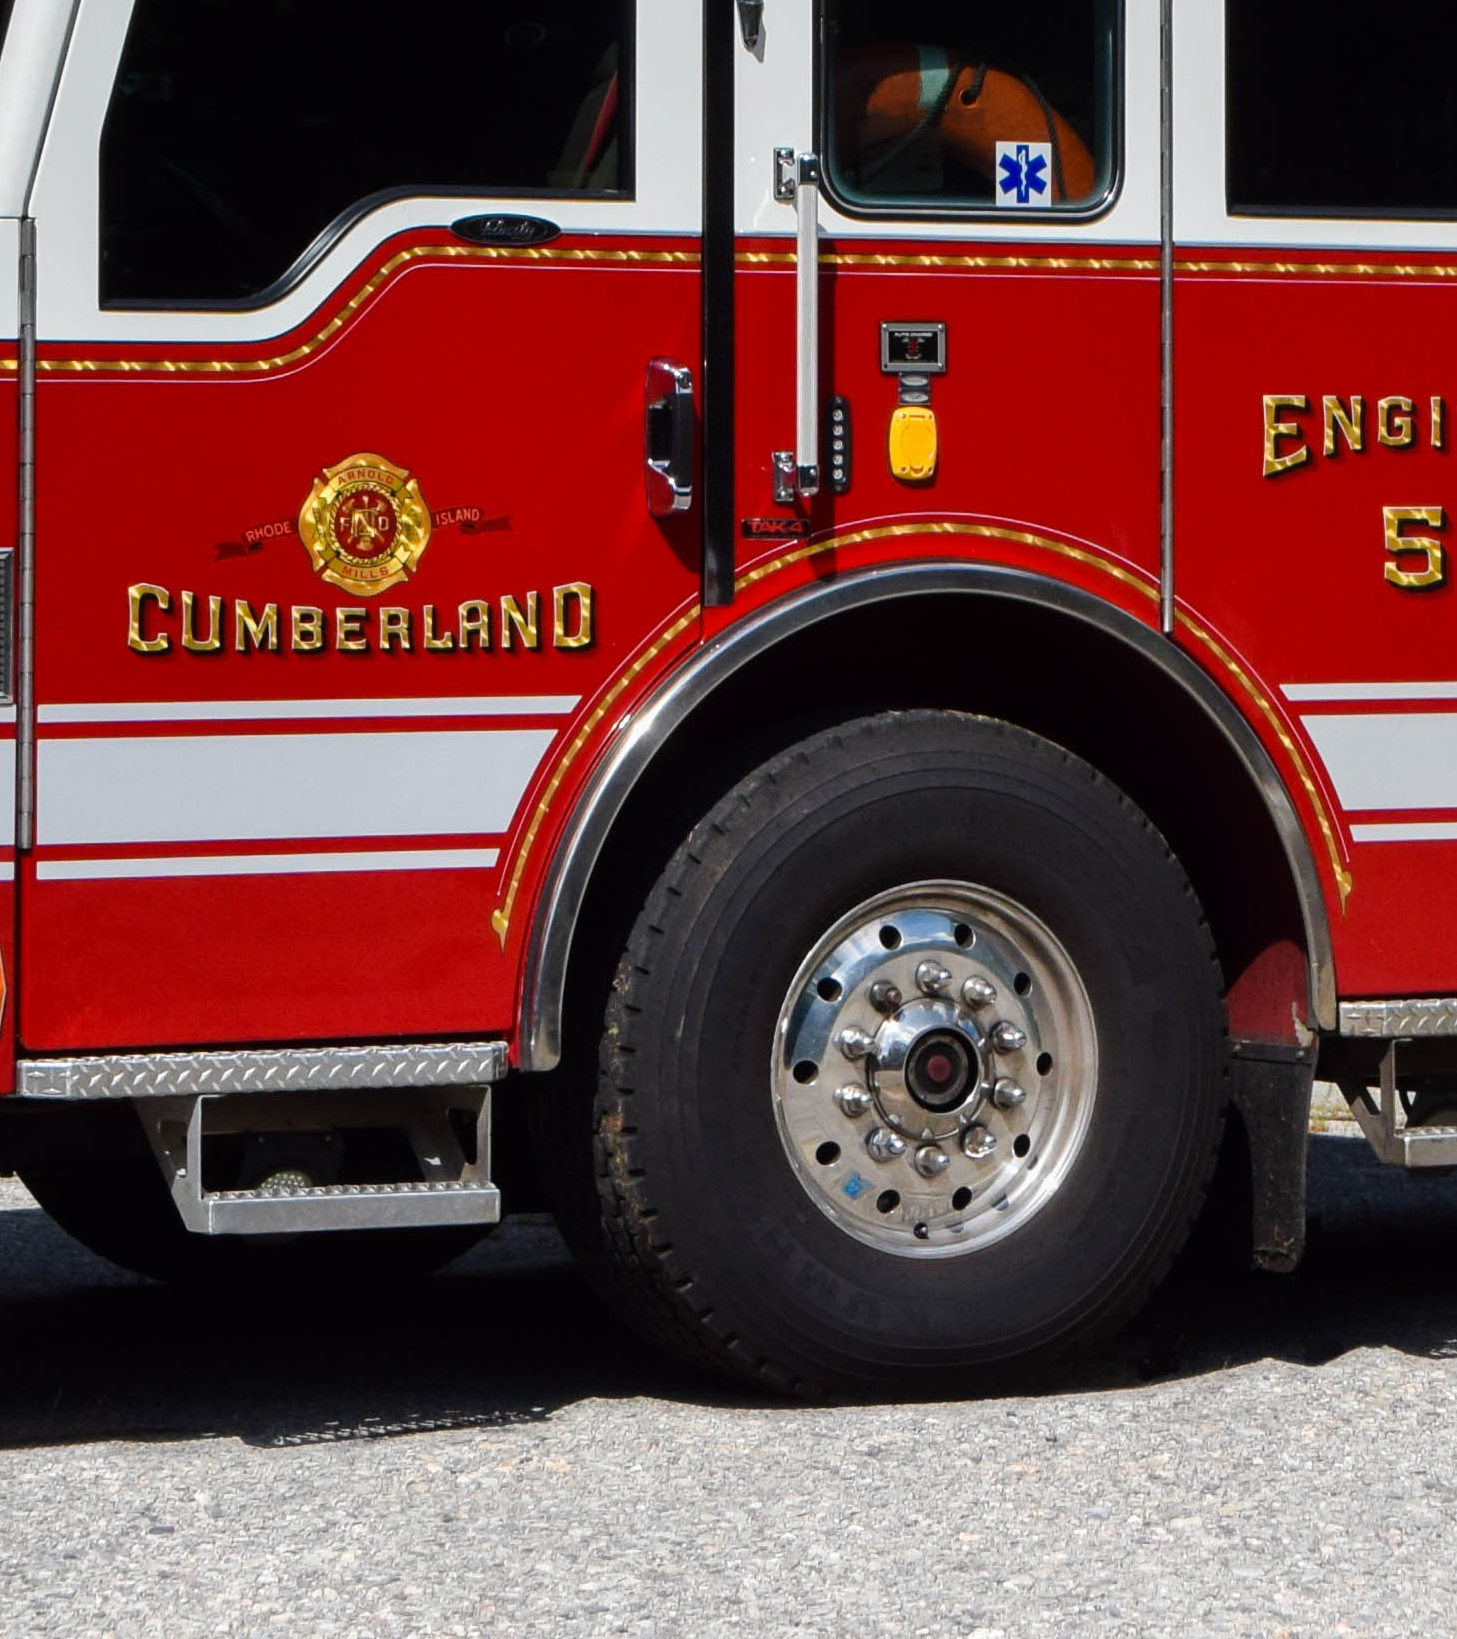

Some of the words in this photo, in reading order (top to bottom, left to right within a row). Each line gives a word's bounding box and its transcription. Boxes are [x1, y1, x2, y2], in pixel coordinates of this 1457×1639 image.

[337, 468, 395, 485] ARNOLD
[245, 521, 292, 543] RHODE
[436, 507, 480, 526] ISLAND
[749, 519, 804, 535] TAK-4
[1382, 505, 1448, 592] 5
[342, 565, 390, 580] MILLS
[127, 581, 595, 654] CUMBERLAND
